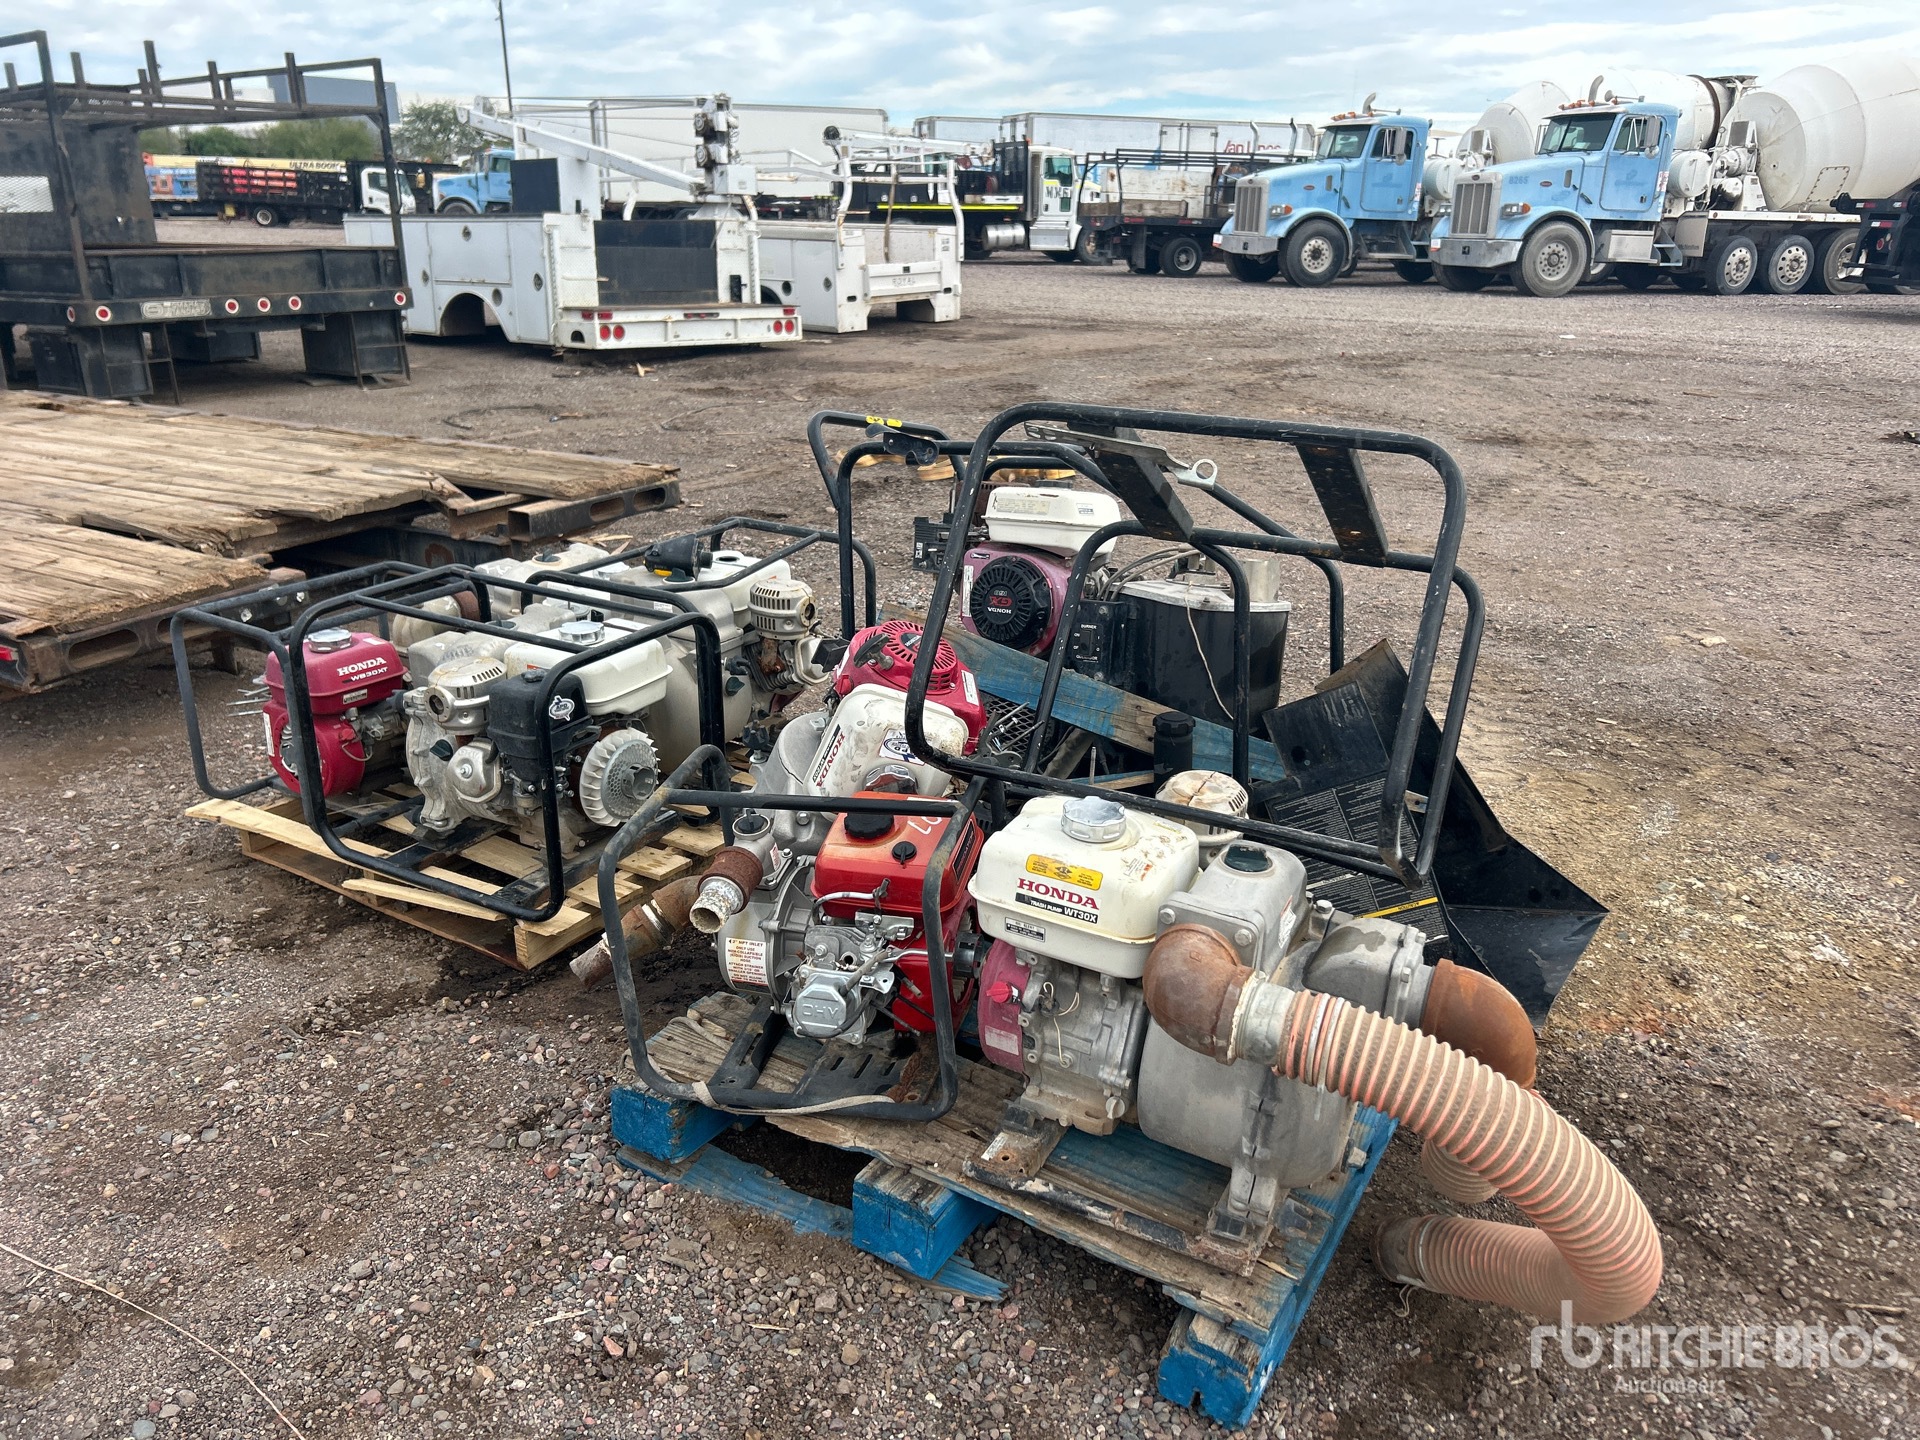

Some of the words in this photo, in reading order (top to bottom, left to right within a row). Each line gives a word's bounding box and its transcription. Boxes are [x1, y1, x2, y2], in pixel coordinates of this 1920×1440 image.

[987, 606, 1012, 614] HONDA
[337, 656, 387, 677] HONDA
[350, 666, 388, 682] WB30XT
[816, 731, 846, 788] HONDA
[1017, 878, 1100, 910] HONDA
[1030, 900, 1047, 909] TRASH
[1047, 904, 1063, 913] PUMP
[1063, 906, 1098, 923] WT30X
[802, 1003, 838, 1020] OHV
